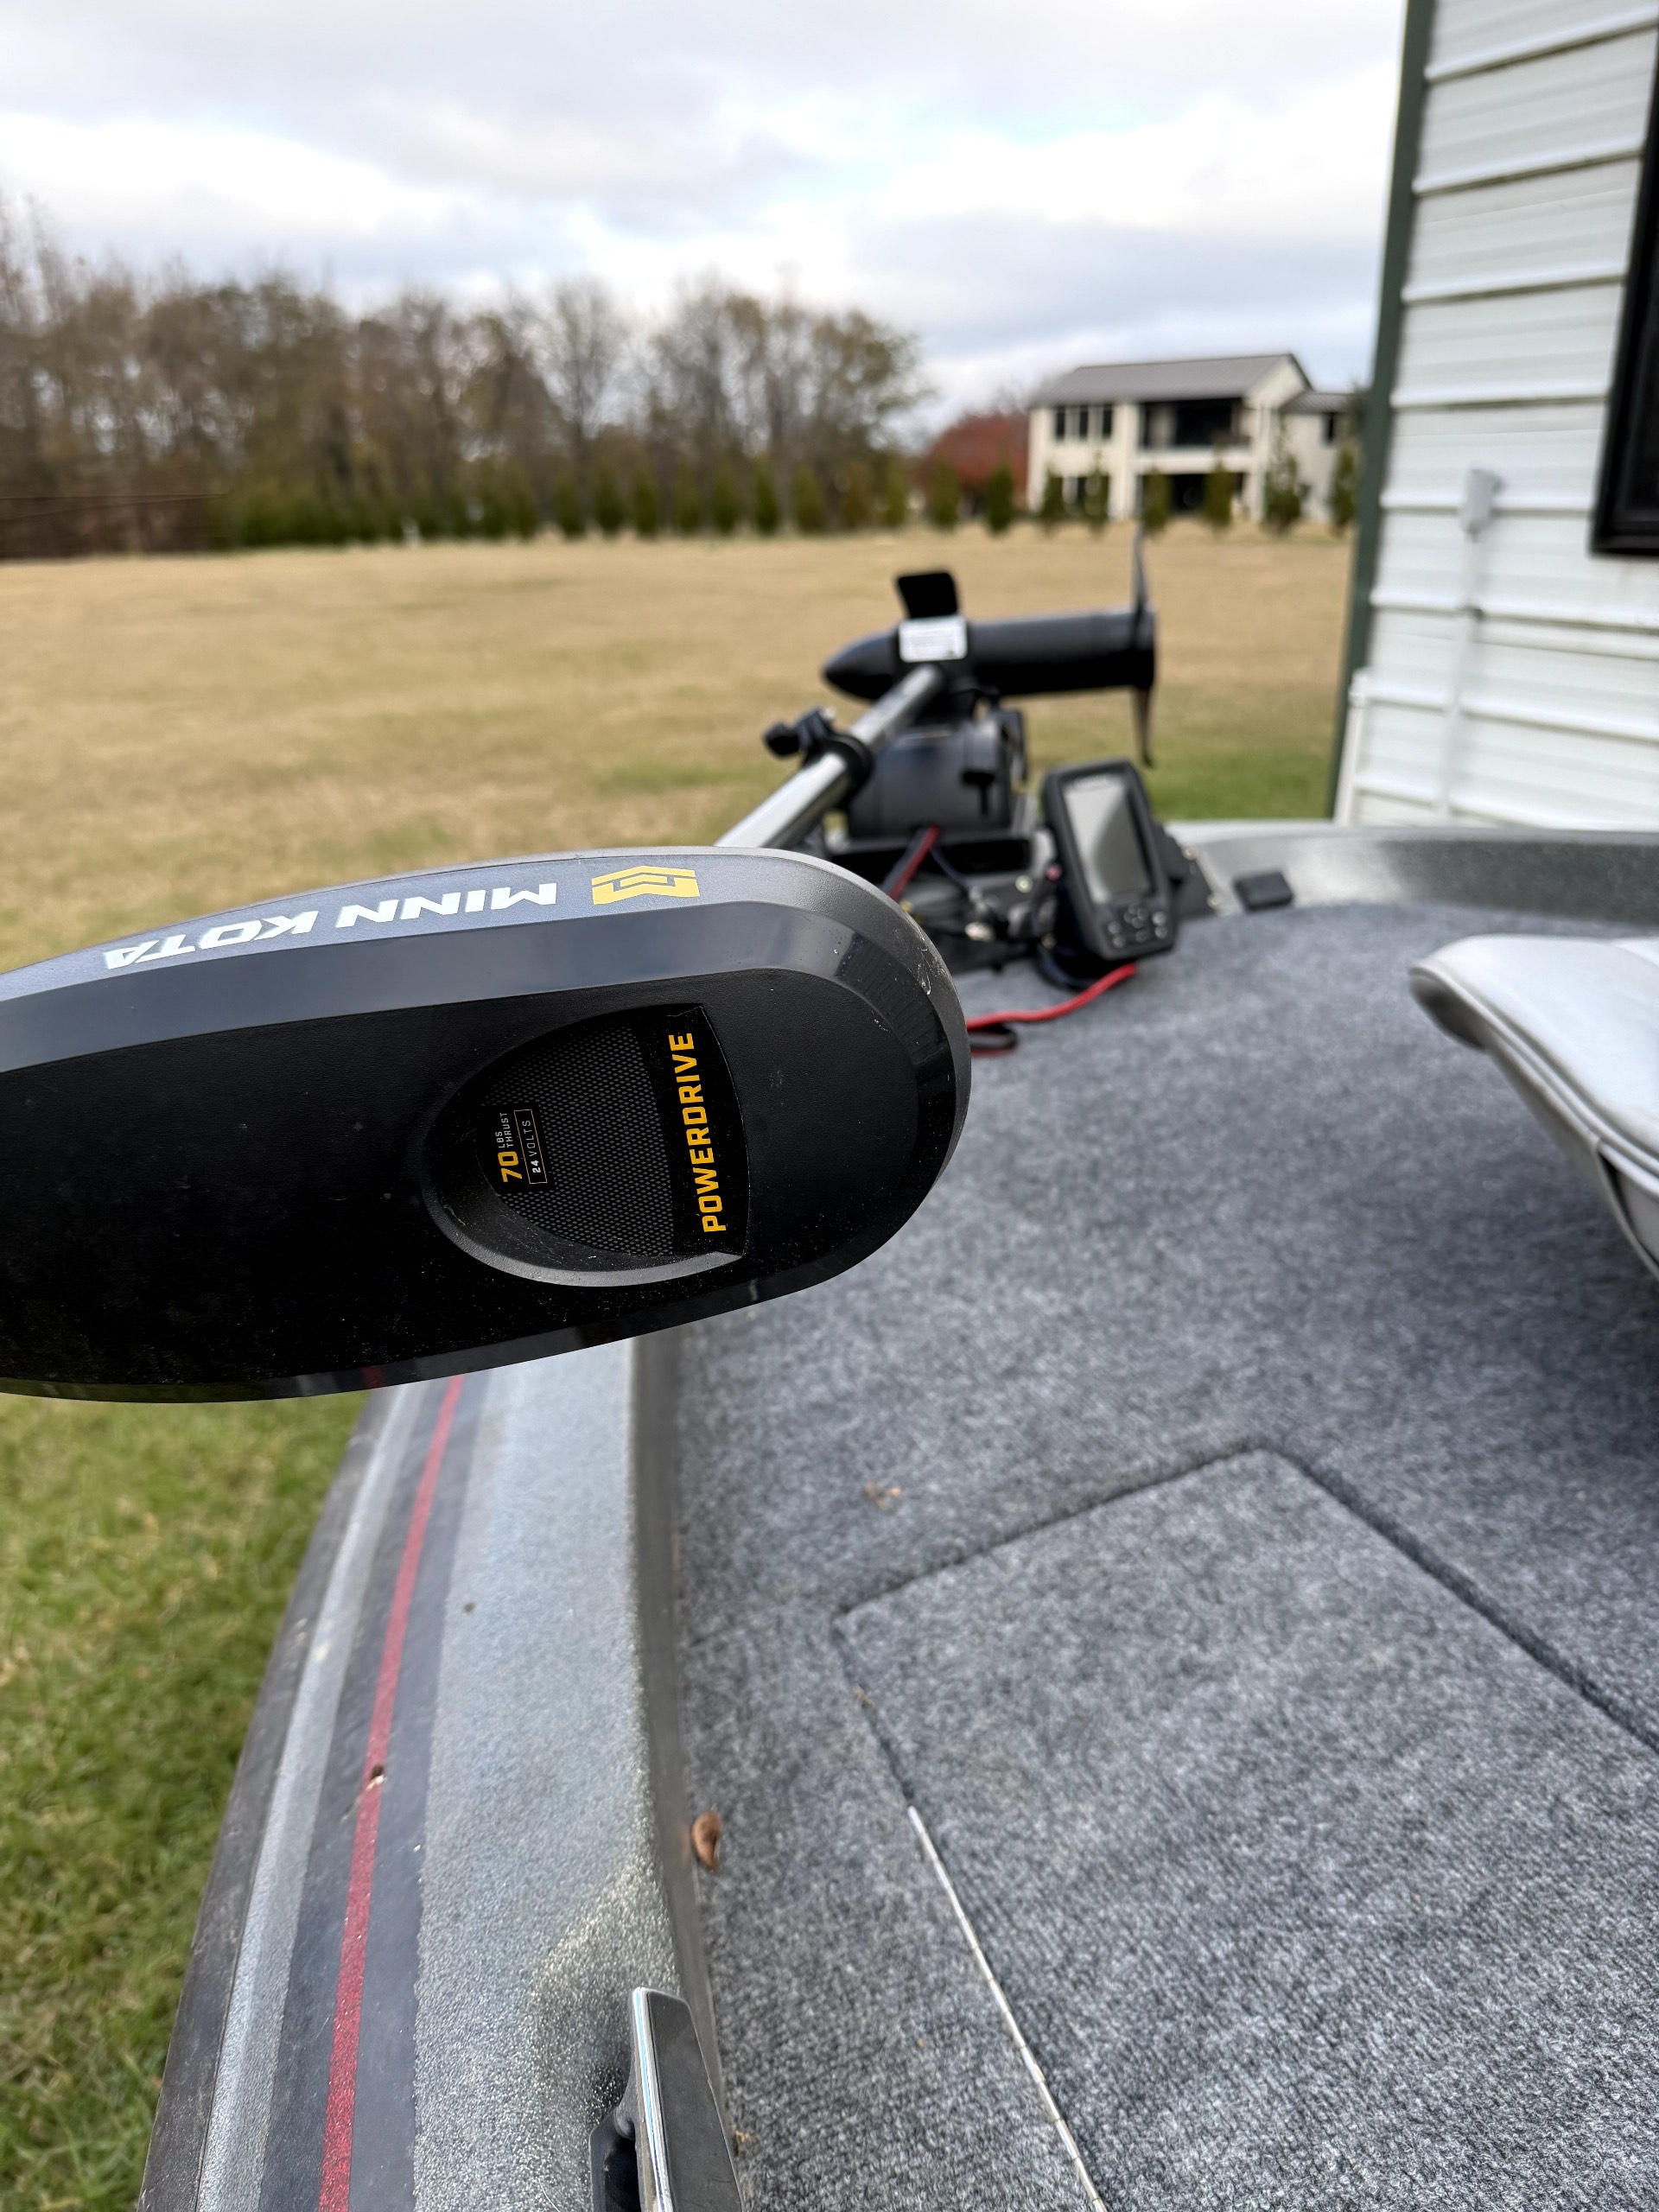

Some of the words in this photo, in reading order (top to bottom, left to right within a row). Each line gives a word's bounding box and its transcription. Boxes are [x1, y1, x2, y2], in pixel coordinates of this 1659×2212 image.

[335, 882, 557, 929] MINN
[103, 910, 319, 969] KOTA
[495, 1131, 505, 1148] LBS
[499, 1112, 514, 1147] THRUST
[522, 1120, 537, 1157] VOLTS
[668, 1033, 726, 1233] POWERDRIVE
[498, 1151, 522, 1182] 70
[530, 1160, 541, 1173] 24
